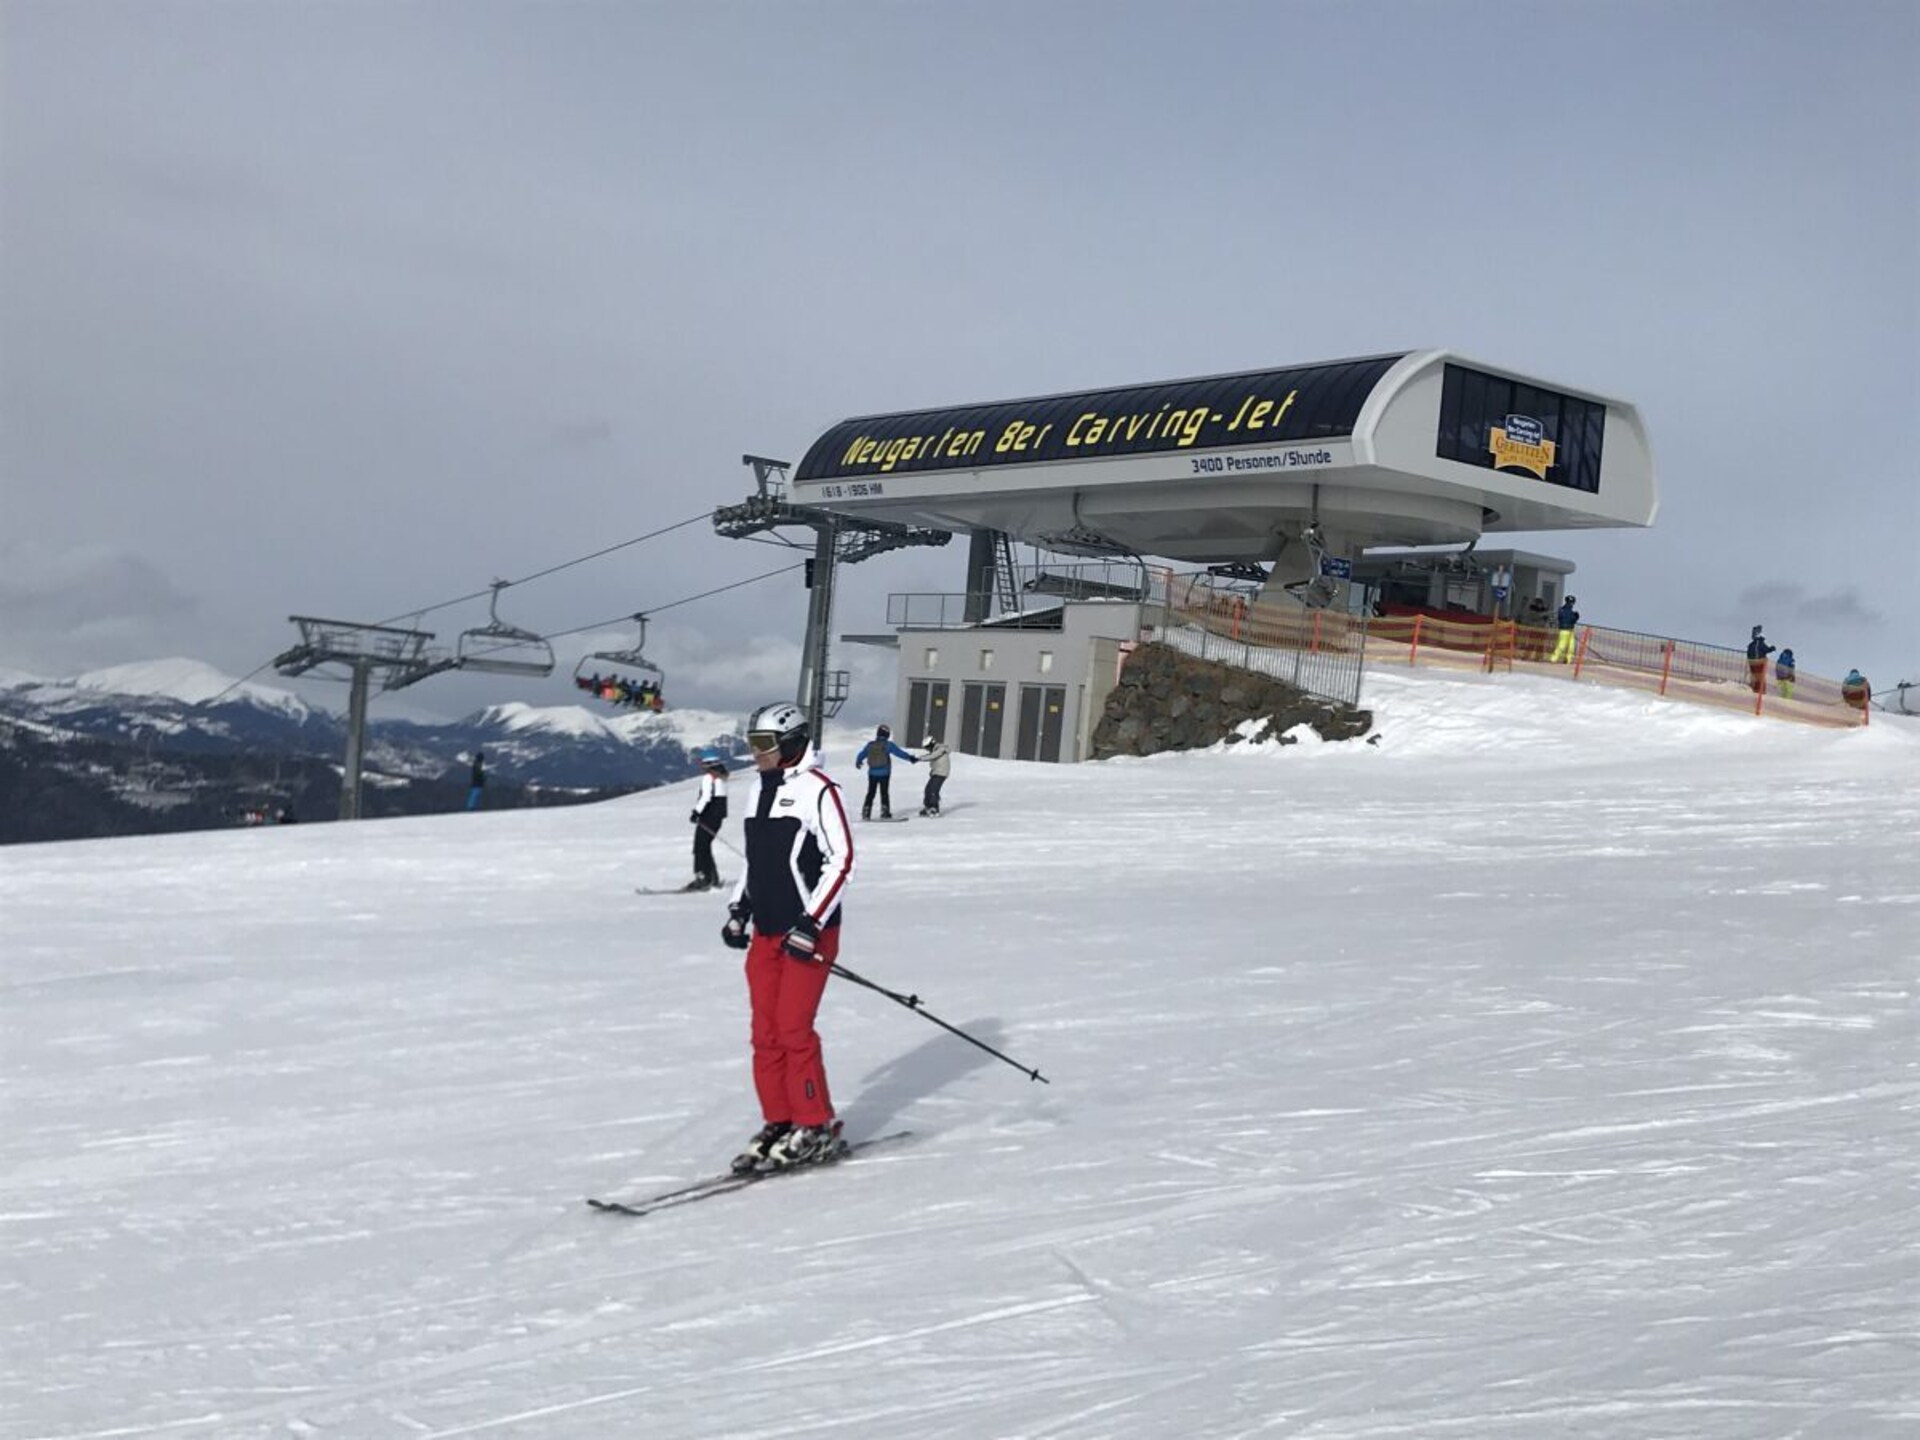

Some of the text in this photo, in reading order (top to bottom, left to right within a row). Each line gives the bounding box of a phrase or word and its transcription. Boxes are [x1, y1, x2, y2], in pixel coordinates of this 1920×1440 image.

[841, 389, 1298, 472] Neugarten 8er Carving-Jet
[1191, 449, 1332, 473] 3400 Personen/Stunde
